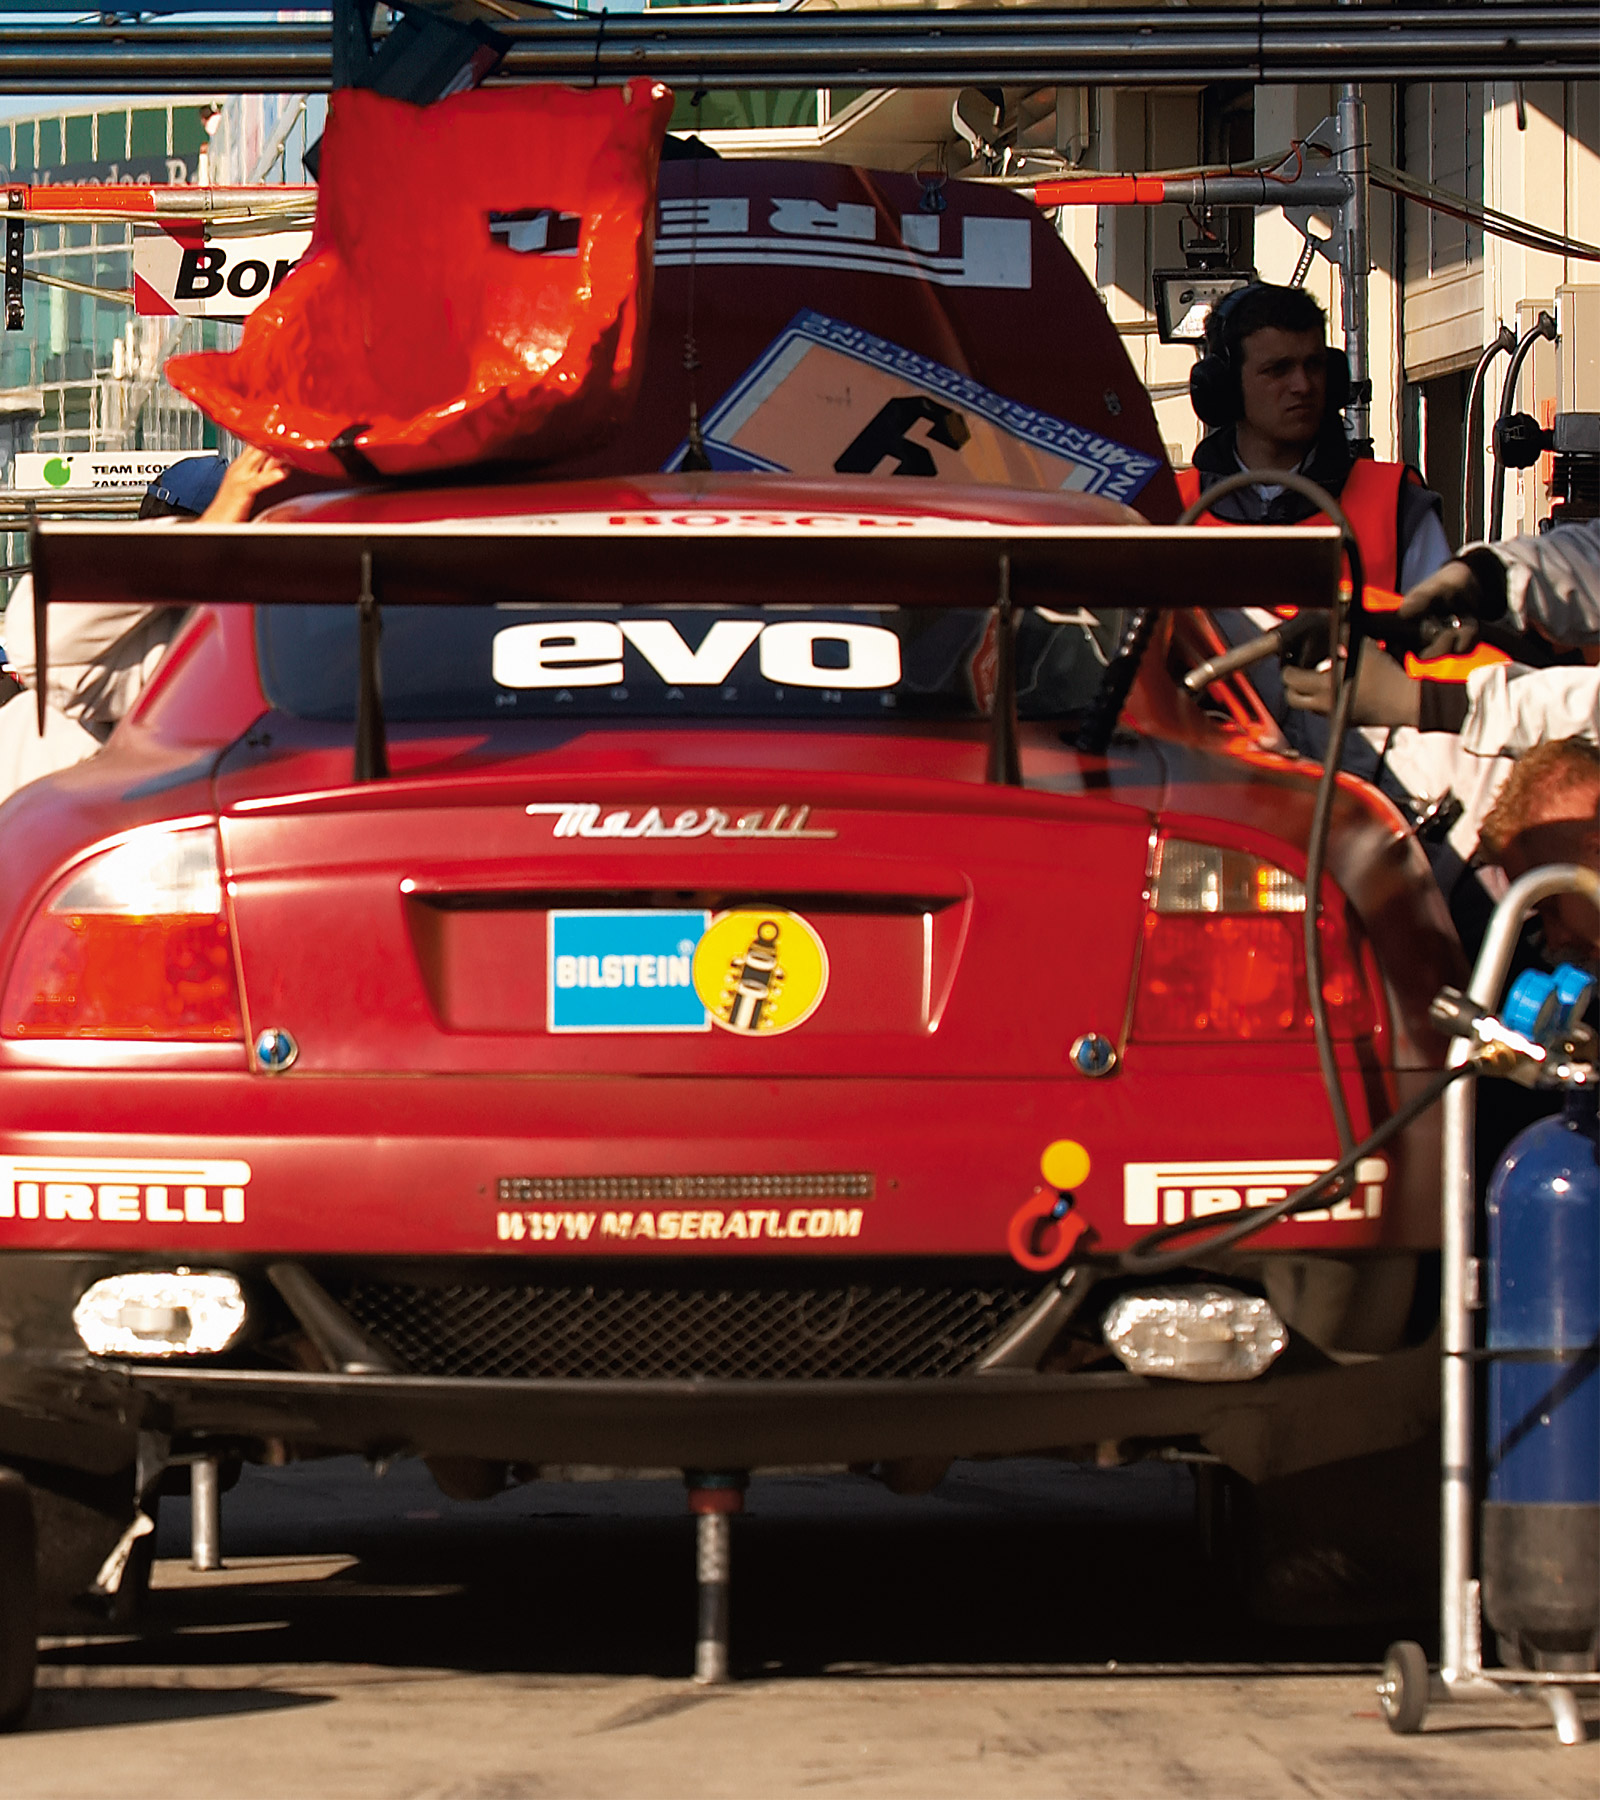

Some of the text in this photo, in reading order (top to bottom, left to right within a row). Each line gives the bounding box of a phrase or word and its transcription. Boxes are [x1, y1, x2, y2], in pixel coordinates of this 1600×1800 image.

[92, 465, 132, 474] TEAM
[492, 619, 902, 689] evo
[525, 803, 839, 839] Maserati
[555, 954, 691, 989] BILSTEIN
